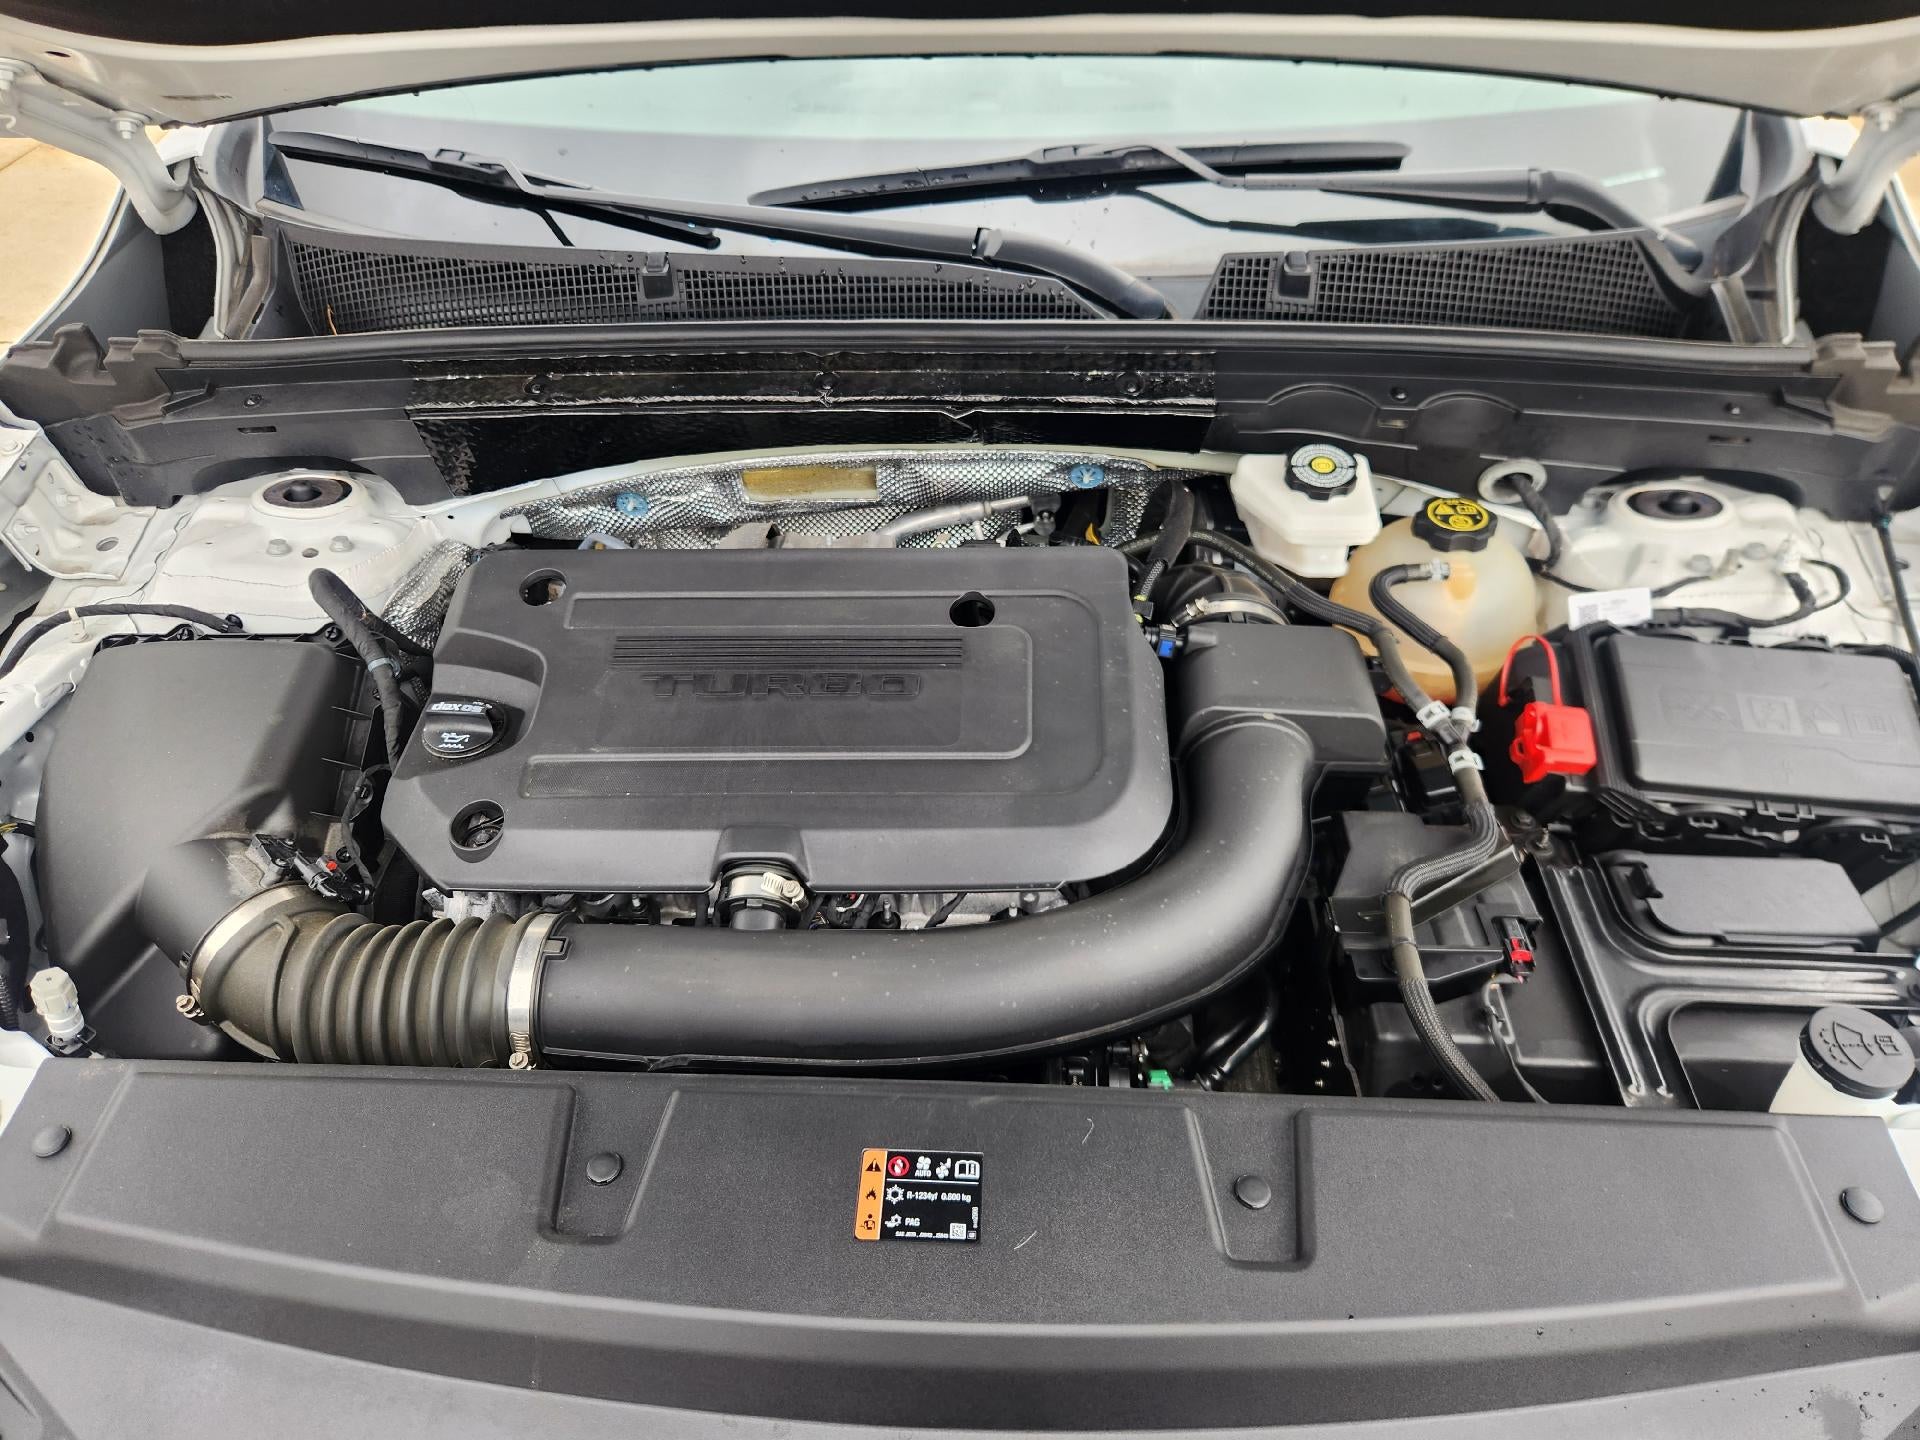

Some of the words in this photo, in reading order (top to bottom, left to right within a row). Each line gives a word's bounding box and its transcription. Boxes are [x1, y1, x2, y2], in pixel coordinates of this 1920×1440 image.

[640, 671, 922, 697] TURBO
[914, 1169, 932, 1177] AUTO
[904, 1217, 921, 1227] PAG
